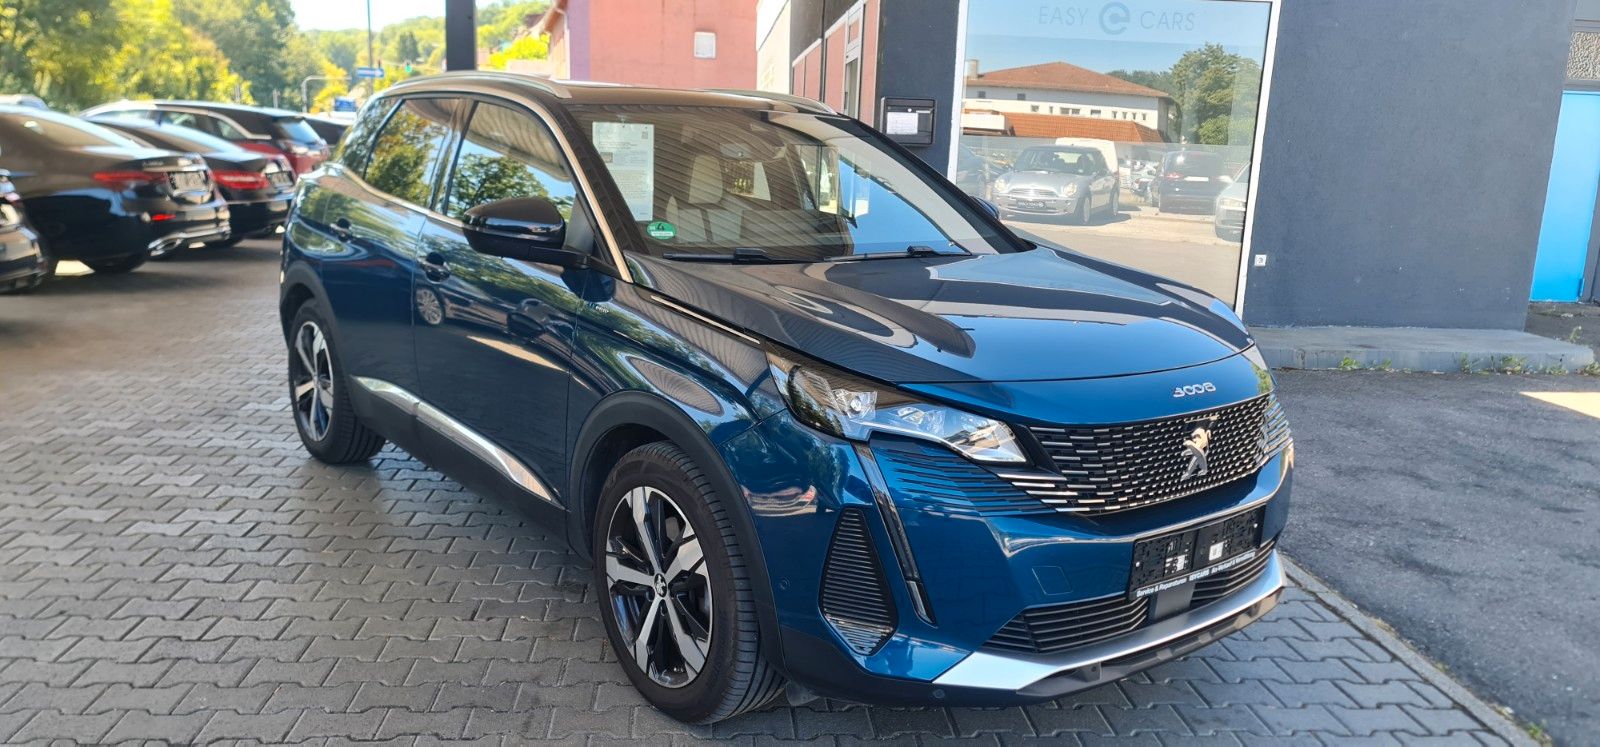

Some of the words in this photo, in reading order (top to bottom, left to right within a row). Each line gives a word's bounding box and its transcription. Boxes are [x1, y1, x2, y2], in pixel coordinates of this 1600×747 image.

[1038, 6, 1088, 26] EASY
[1139, 10, 1196, 32] CARS
[1173, 382, 1216, 398] 3008
